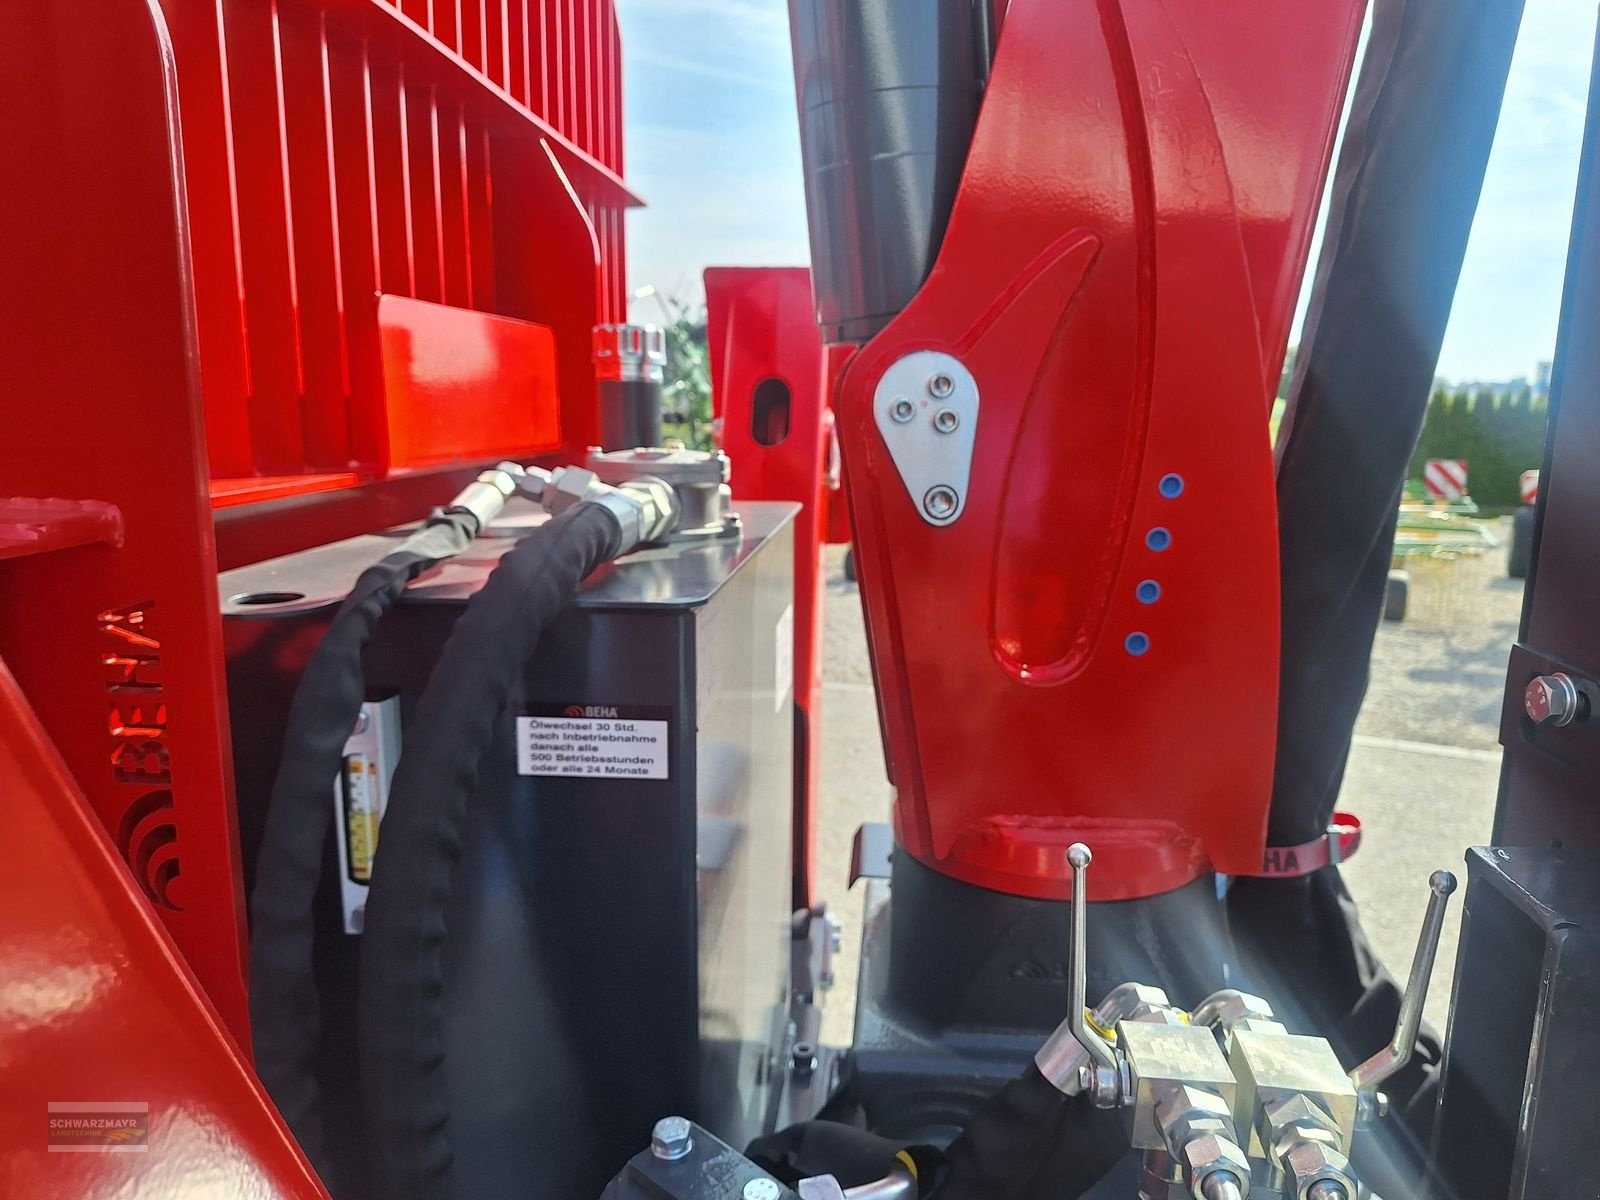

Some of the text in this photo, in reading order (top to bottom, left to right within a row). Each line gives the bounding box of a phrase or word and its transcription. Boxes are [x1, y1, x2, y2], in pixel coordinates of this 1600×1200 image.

[97, 599, 174, 784] BEHA
[586, 706, 617, 718] BEHA
[529, 719, 638, 733] Ölwechsel 30 Std.
[530, 732, 657, 743] nach Inbetriebnahme
[530, 743, 599, 752] danach alle
[531, 753, 654, 765] 500 Betriebsstunden
[531, 764, 649, 775] oder alle 24 Monate
[1263, 849, 1300, 873] HA
